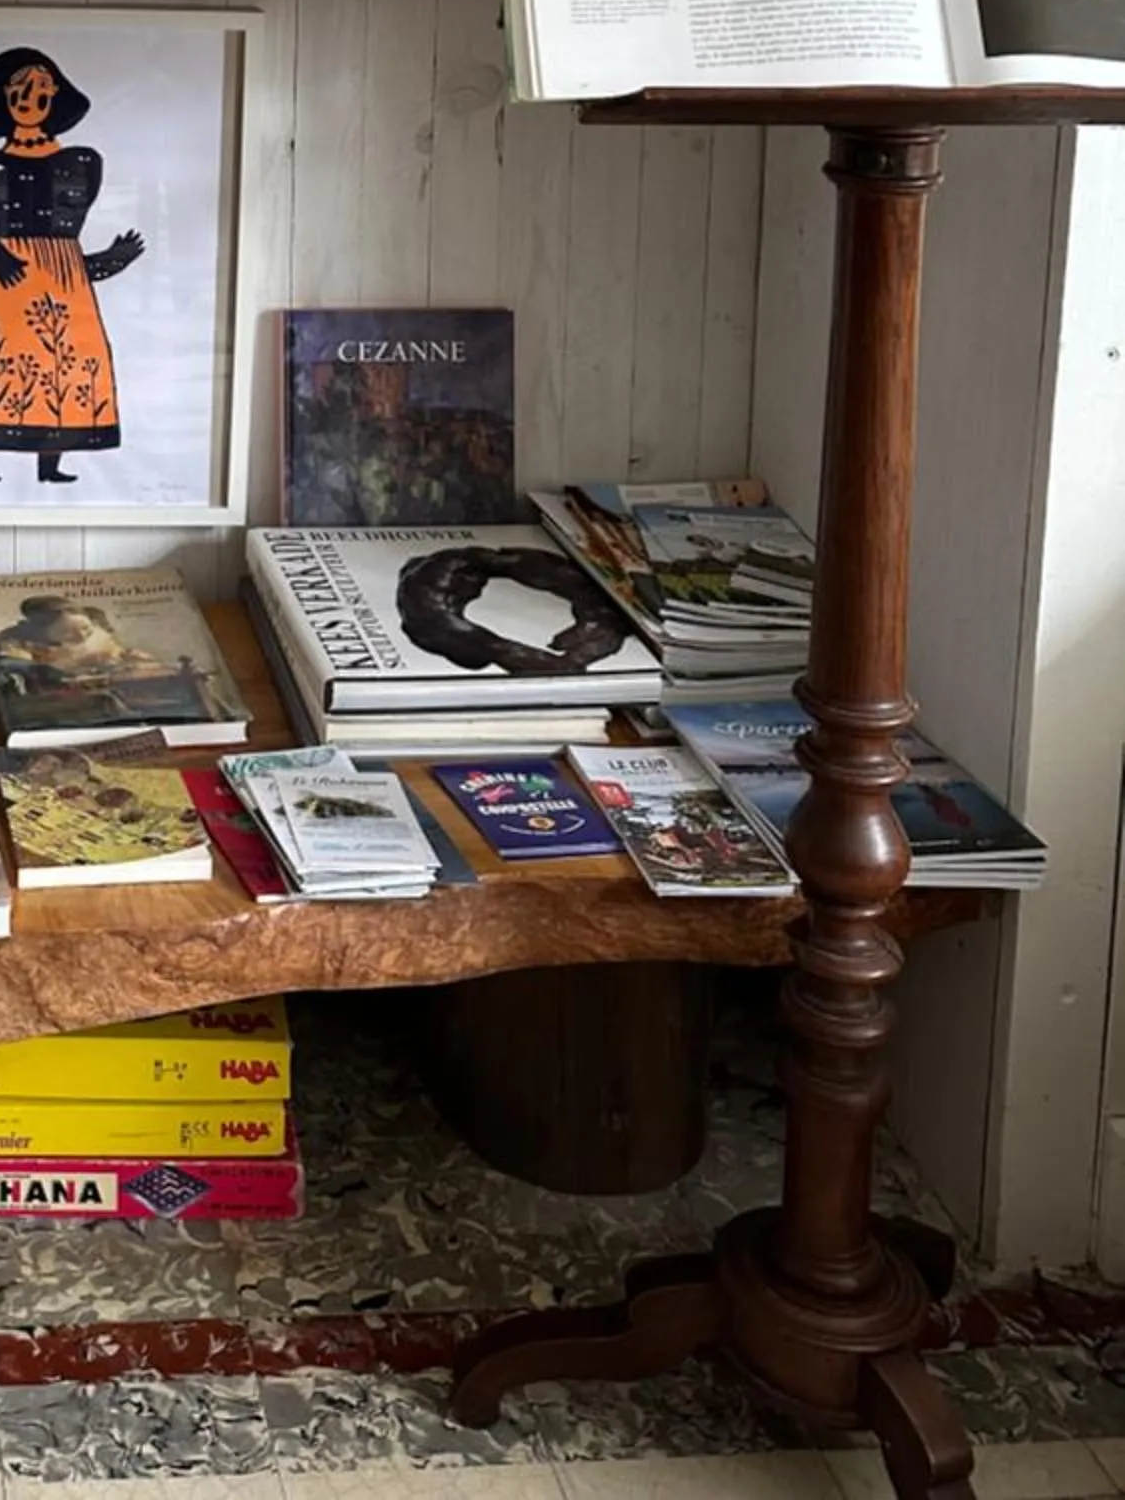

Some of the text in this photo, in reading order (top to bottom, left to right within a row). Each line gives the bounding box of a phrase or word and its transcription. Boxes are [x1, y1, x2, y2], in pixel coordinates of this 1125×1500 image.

[336, 339, 468, 363] CEZANNE
[308, 529, 477, 544] BEELDHOUWER
[262, 531, 380, 672] KEES VERKADE
[189, 1011, 275, 1034] HABA
[220, 1059, 279, 1084] HABA
[220, 1121, 272, 1142] HABA
